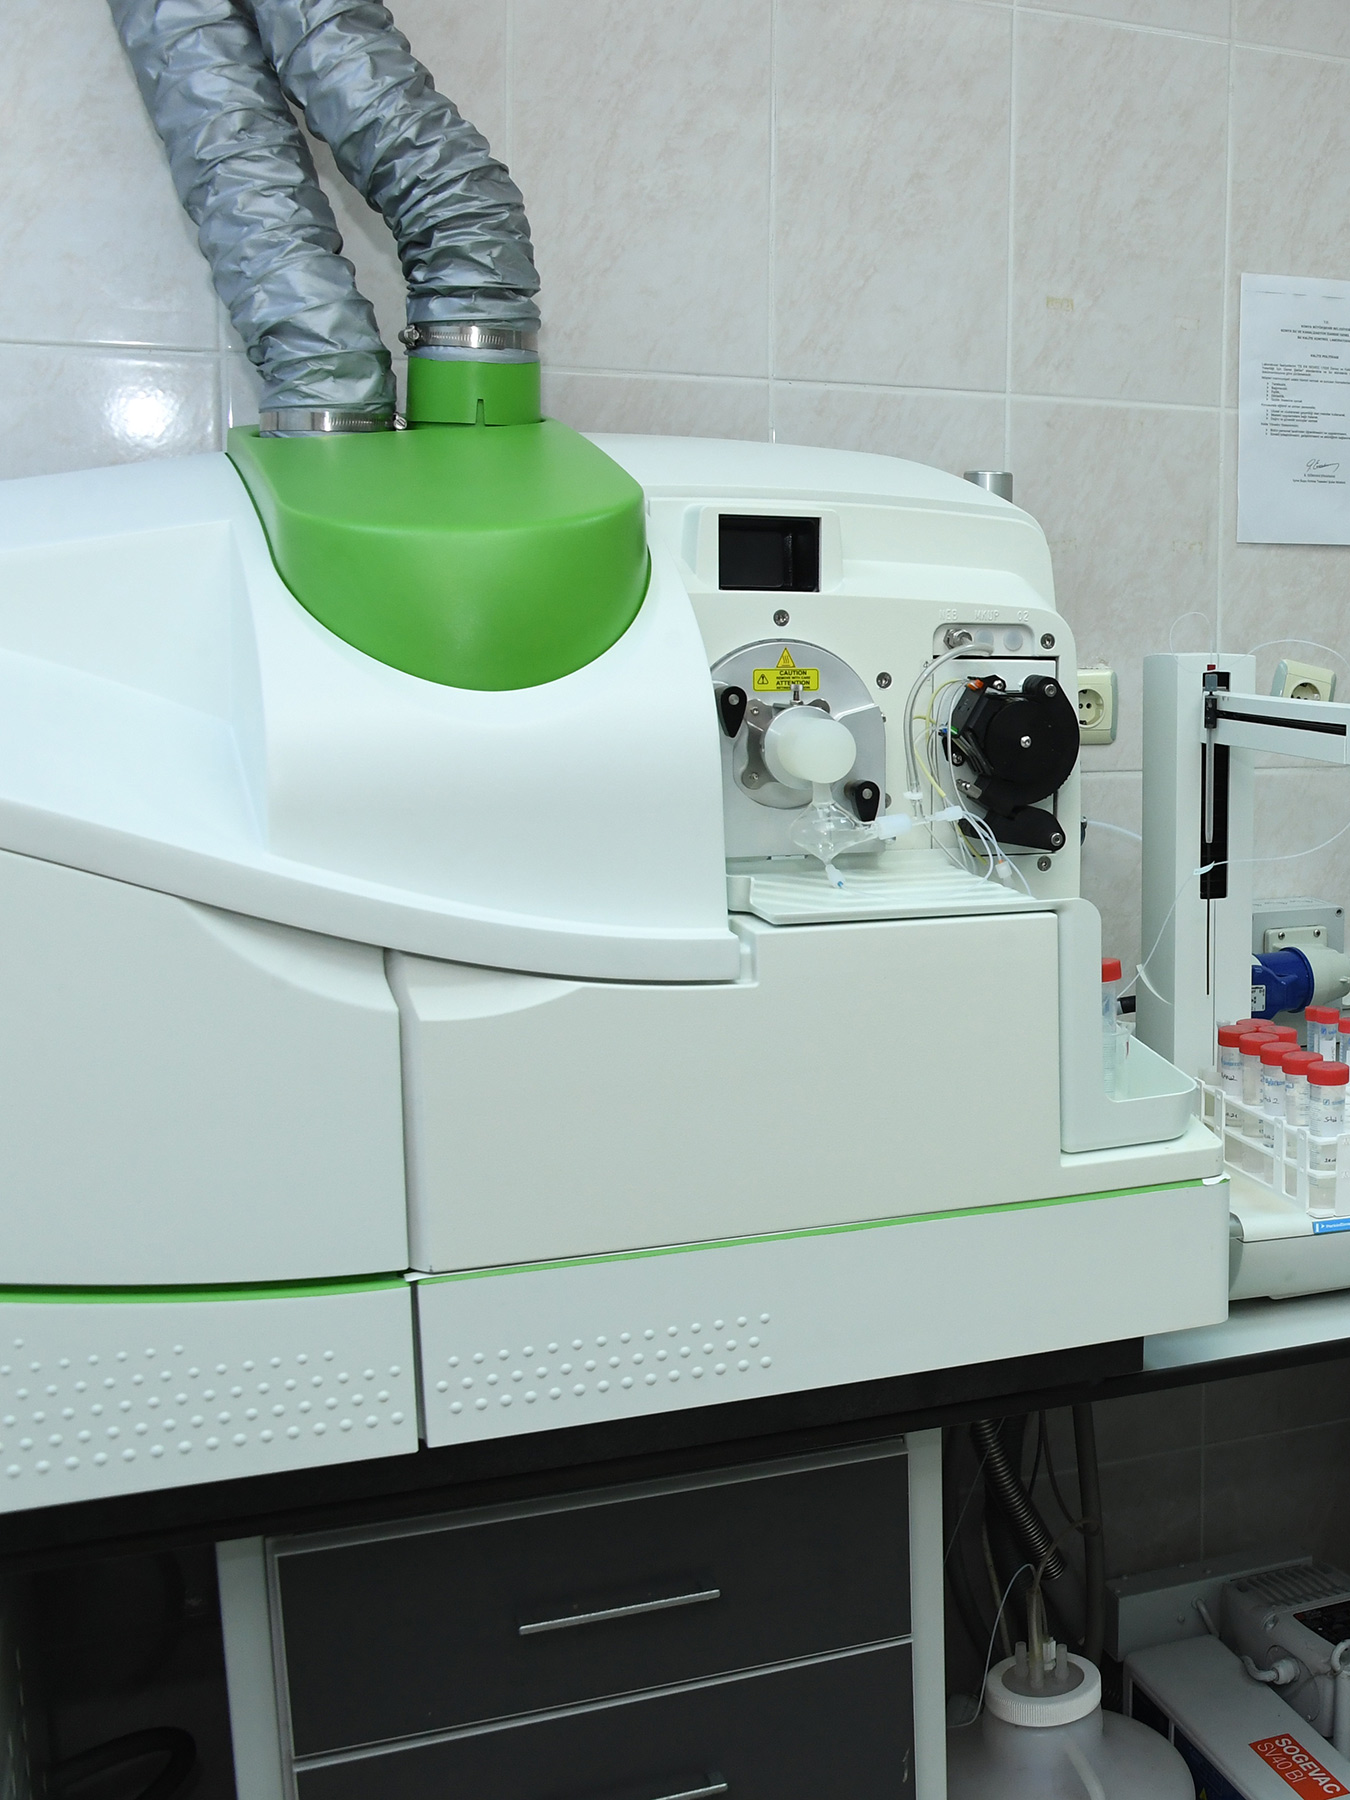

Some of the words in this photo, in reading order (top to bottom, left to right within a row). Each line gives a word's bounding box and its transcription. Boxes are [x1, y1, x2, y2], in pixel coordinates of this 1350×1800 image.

[974, 609, 1000, 621] MKUP
[1257, 1742, 1293, 1770] SV40
[1285, 1769, 1307, 1783] BI
[1274, 1737, 1341, 1794] SOGEVAC
